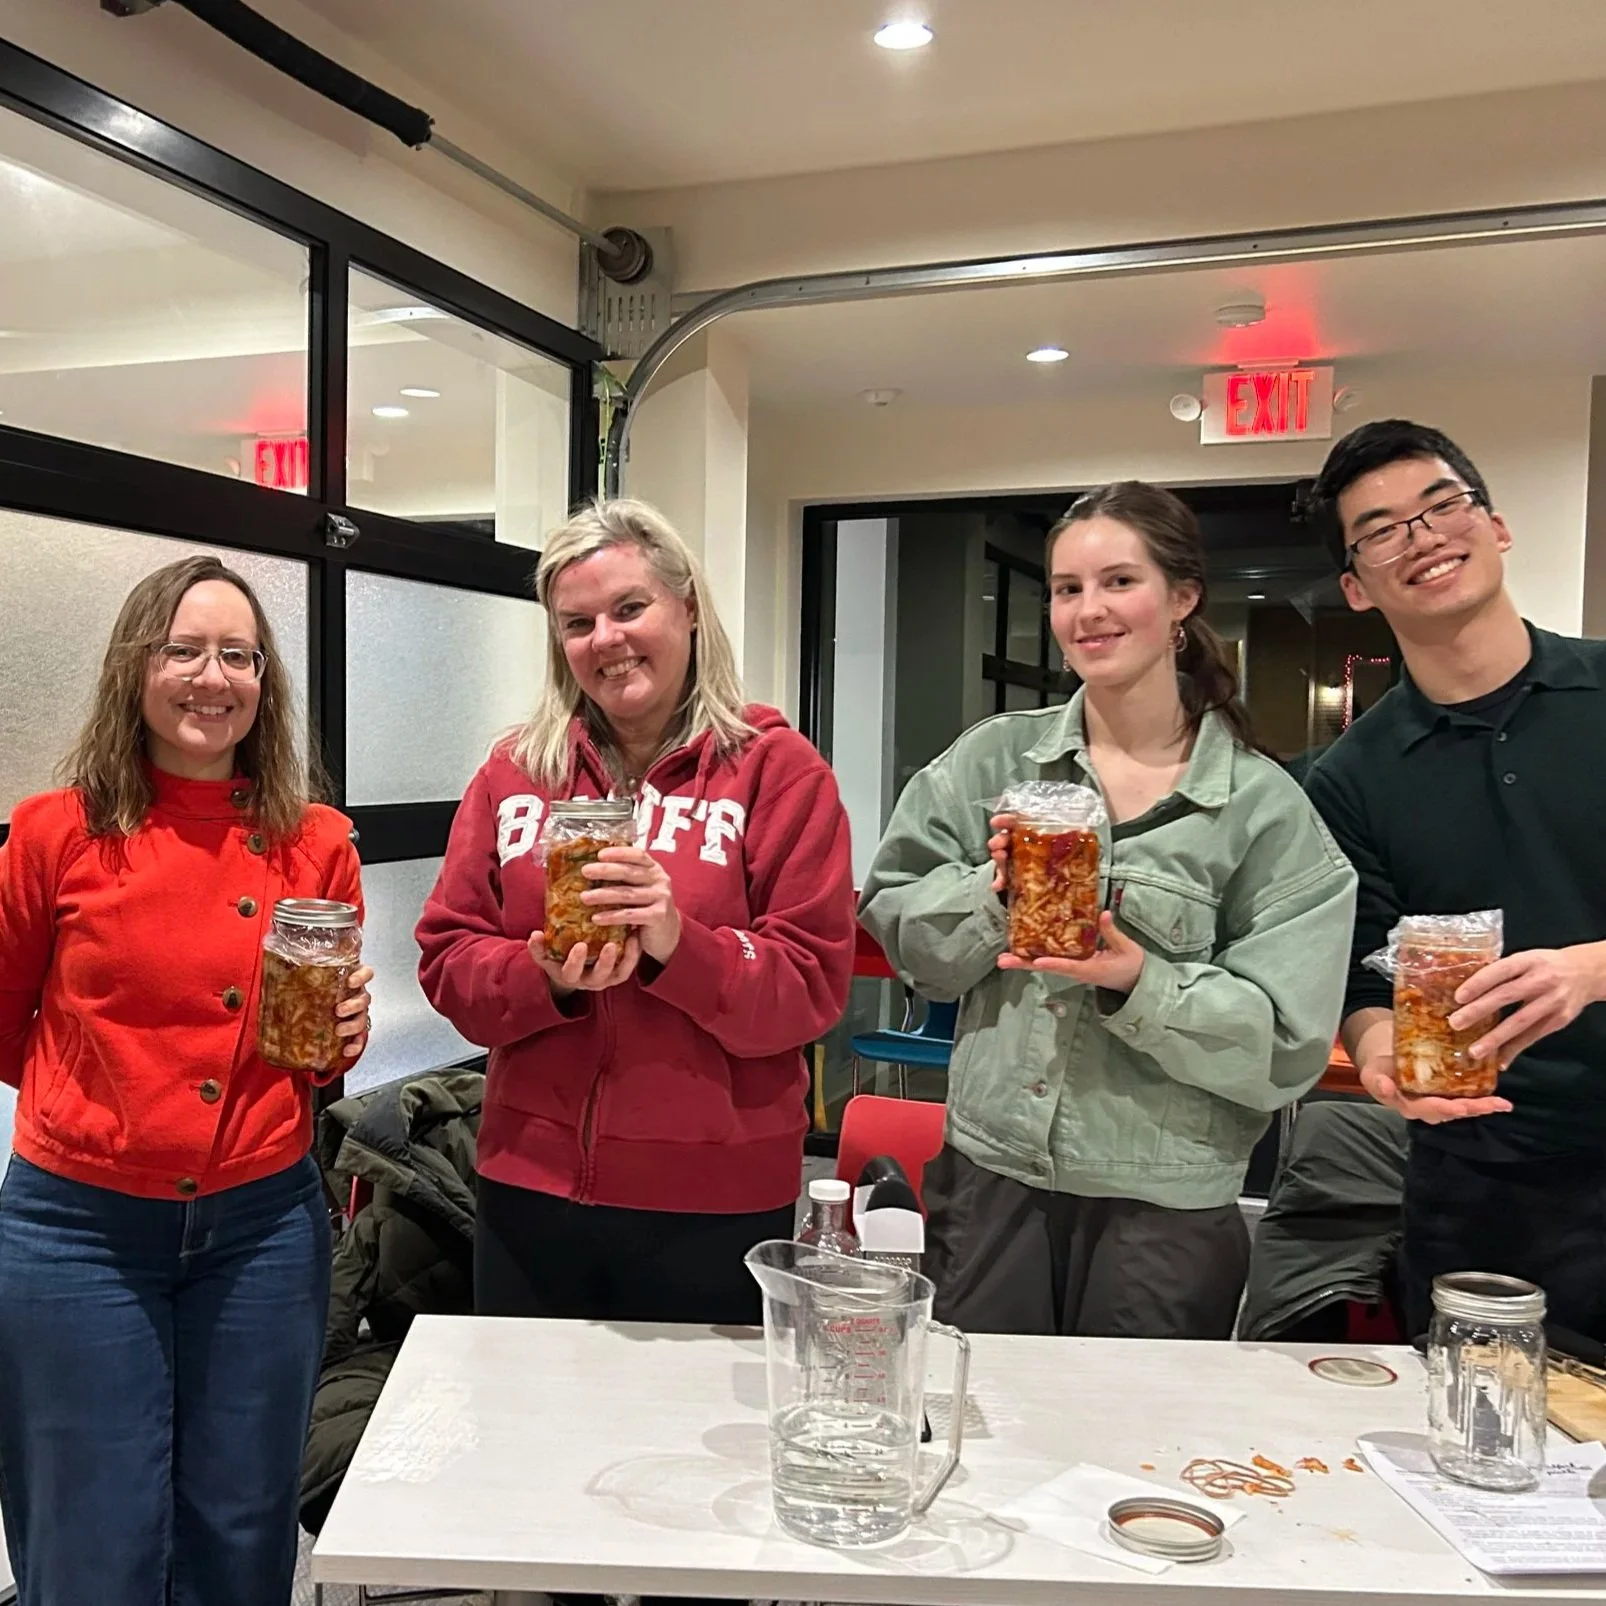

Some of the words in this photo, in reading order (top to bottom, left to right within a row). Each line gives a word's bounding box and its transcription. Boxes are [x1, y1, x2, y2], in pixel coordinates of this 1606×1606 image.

[1225, 371, 1314, 436] EXIT
[255, 439, 308, 488] EXIT
[497, 781, 747, 868] BFF
